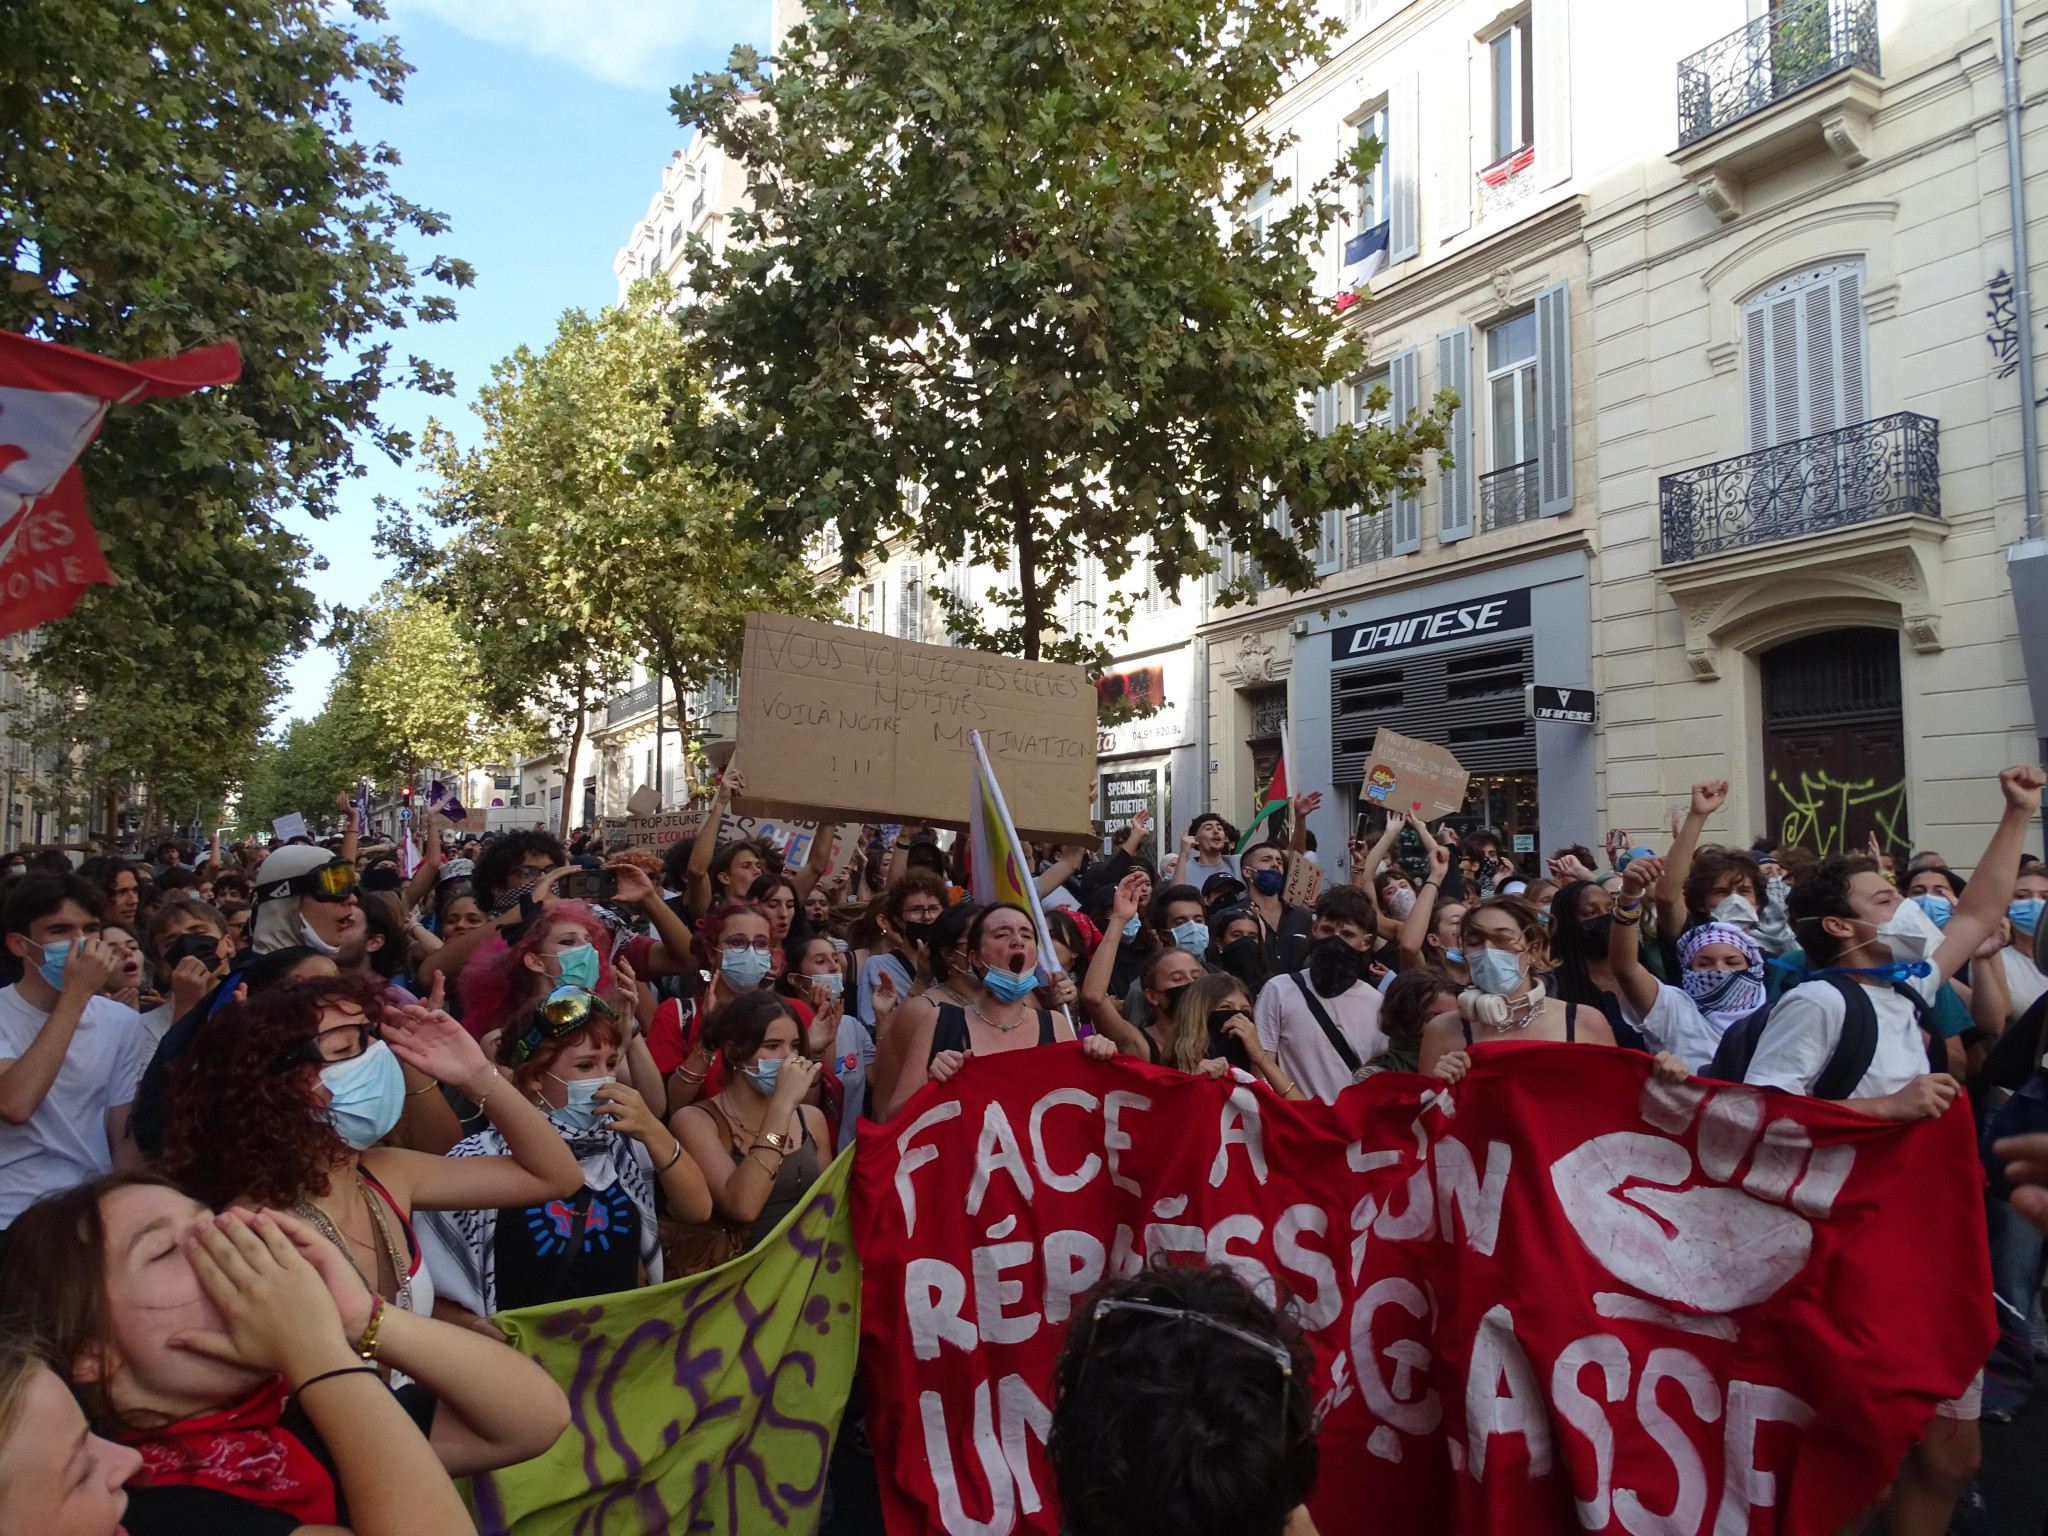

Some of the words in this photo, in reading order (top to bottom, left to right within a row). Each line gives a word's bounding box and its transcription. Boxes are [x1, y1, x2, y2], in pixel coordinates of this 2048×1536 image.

[1349, 600, 1508, 653] DAINESE
[763, 625, 845, 669] VOUS
[864, 640, 960, 686] VOULIEZ
[976, 662, 1006, 691] DES
[839, 708, 901, 735] NOTRE
[1536, 707, 1593, 722] DAINESE
[1107, 779, 1151, 796] SPECIALISTE
[1110, 799, 1148, 815] ENTRETIEN
[631, 817, 662, 829] TROP
[663, 813, 702, 827] JEUNE
[895, 1087, 1152, 1239] FACE
